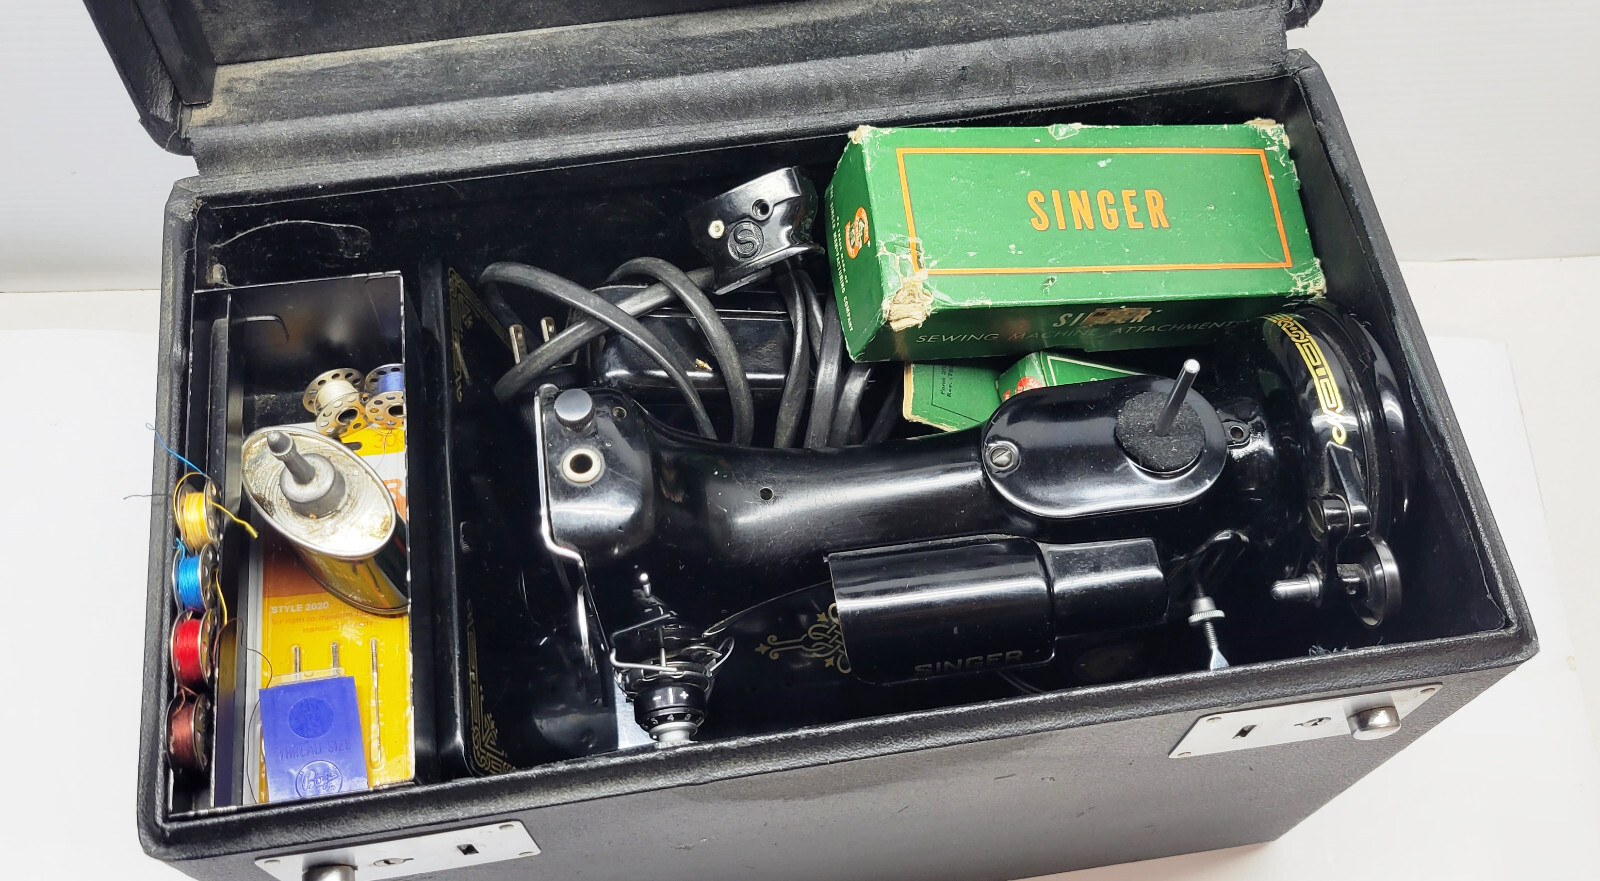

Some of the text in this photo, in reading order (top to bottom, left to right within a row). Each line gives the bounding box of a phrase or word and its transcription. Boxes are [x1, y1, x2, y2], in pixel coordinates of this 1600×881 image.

[1027, 188, 1171, 232] SINGER
[843, 295, 854, 332] COMPANY
[1053, 308, 1152, 329] SIR
[916, 318, 1243, 344] SEWING MACHINE ATTACHMENT
[271, 601, 329, 614] STYLE 2020
[913, 648, 1023, 676] SINGER
[667, 713, 675, 722] 4
